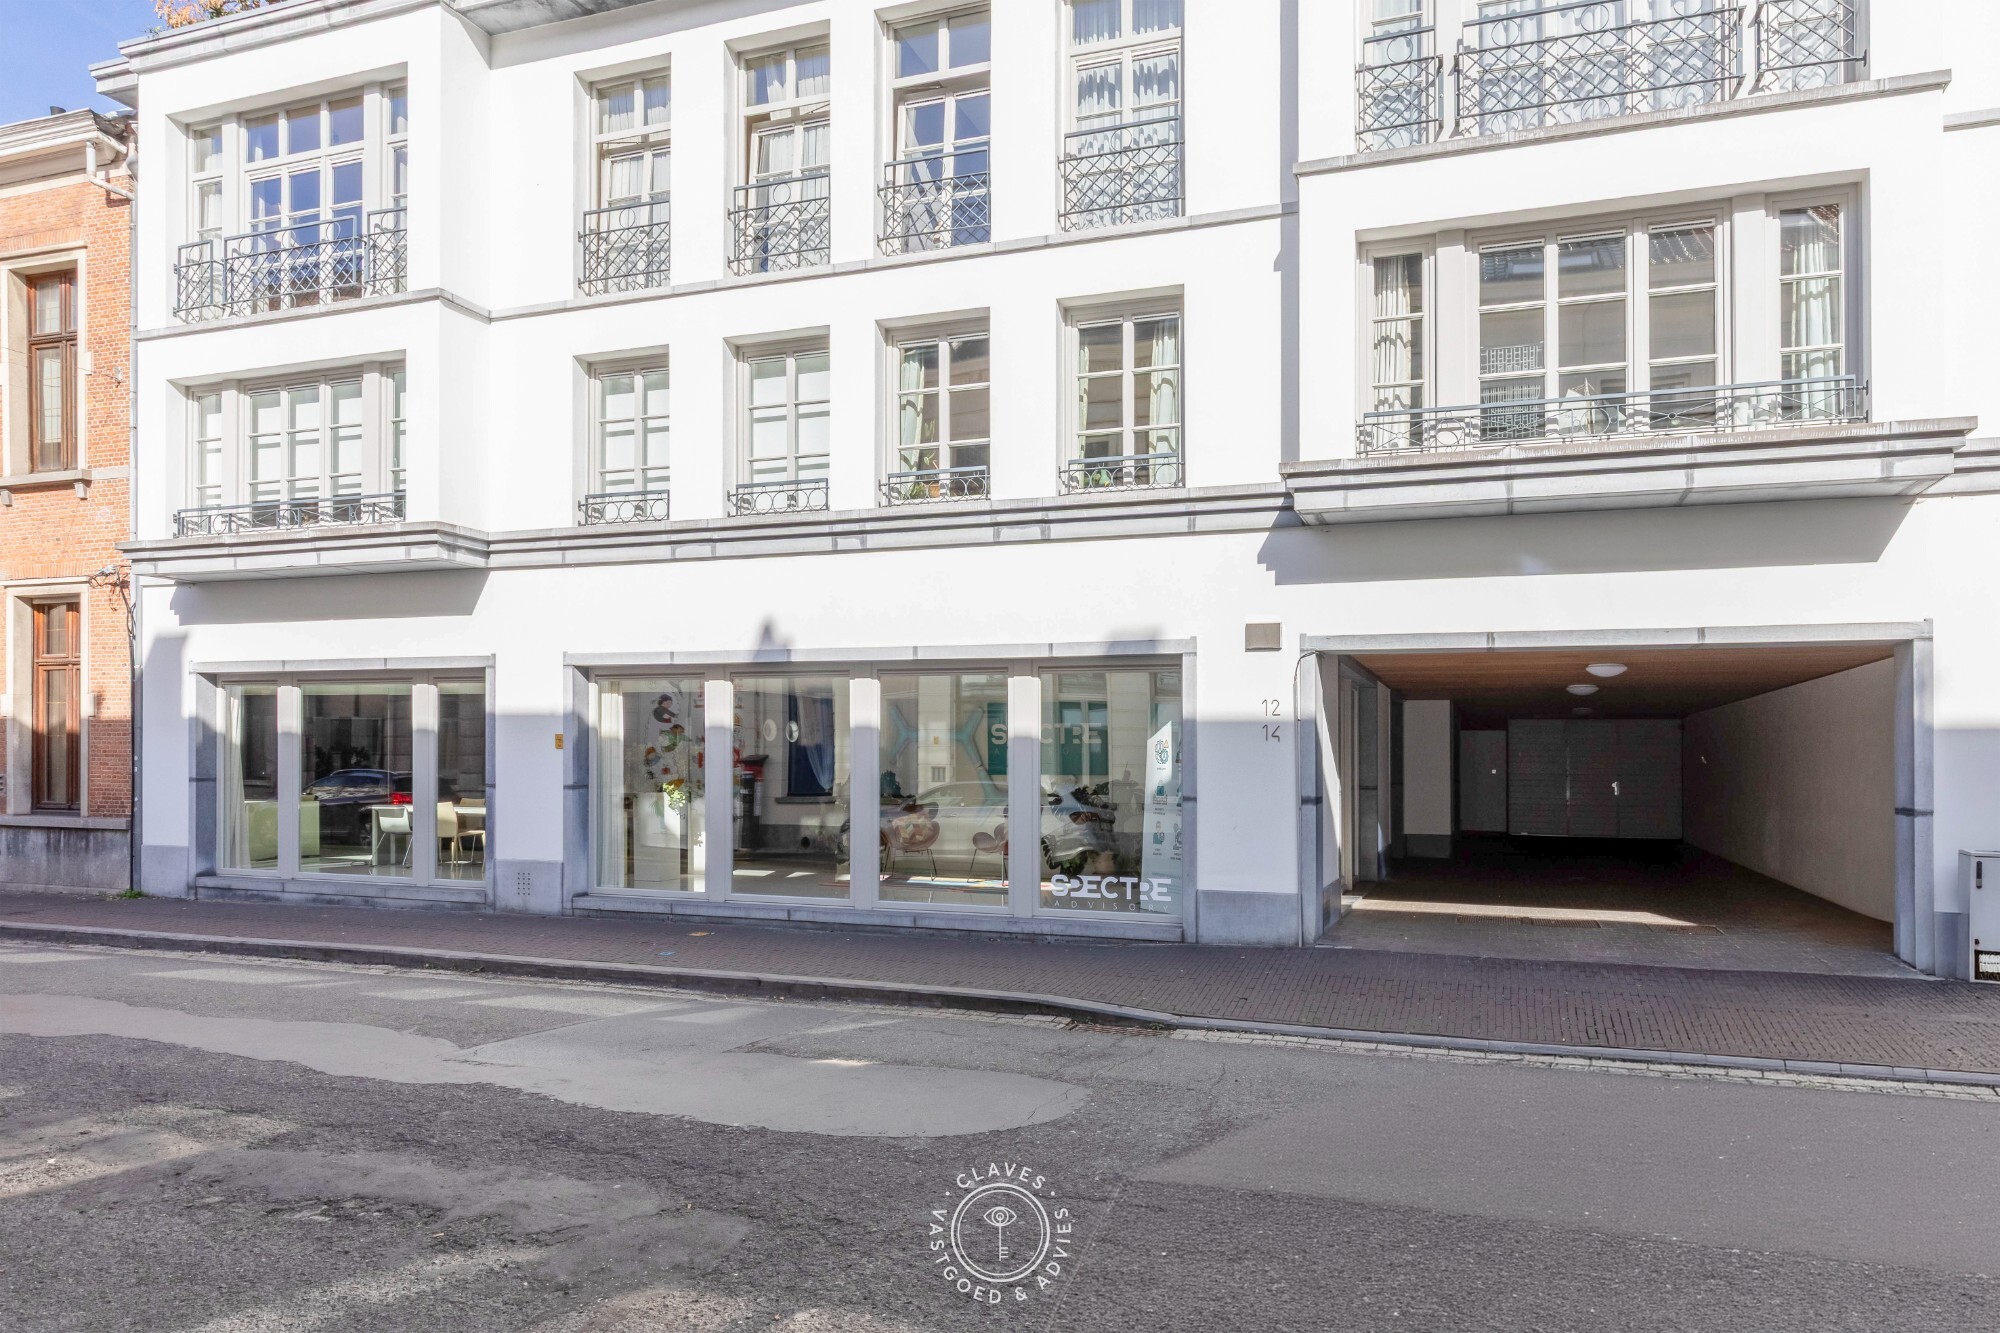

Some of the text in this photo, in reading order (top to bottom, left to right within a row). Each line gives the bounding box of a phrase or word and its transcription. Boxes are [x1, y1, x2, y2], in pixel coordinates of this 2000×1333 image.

[1261, 699, 1280, 716] 12
[991, 723, 1102, 745] SCTRE
[1262, 724, 1280, 742] 14
[1051, 874, 1172, 902] SPECTRE
[1054, 900, 1168, 912] ADVISORY
